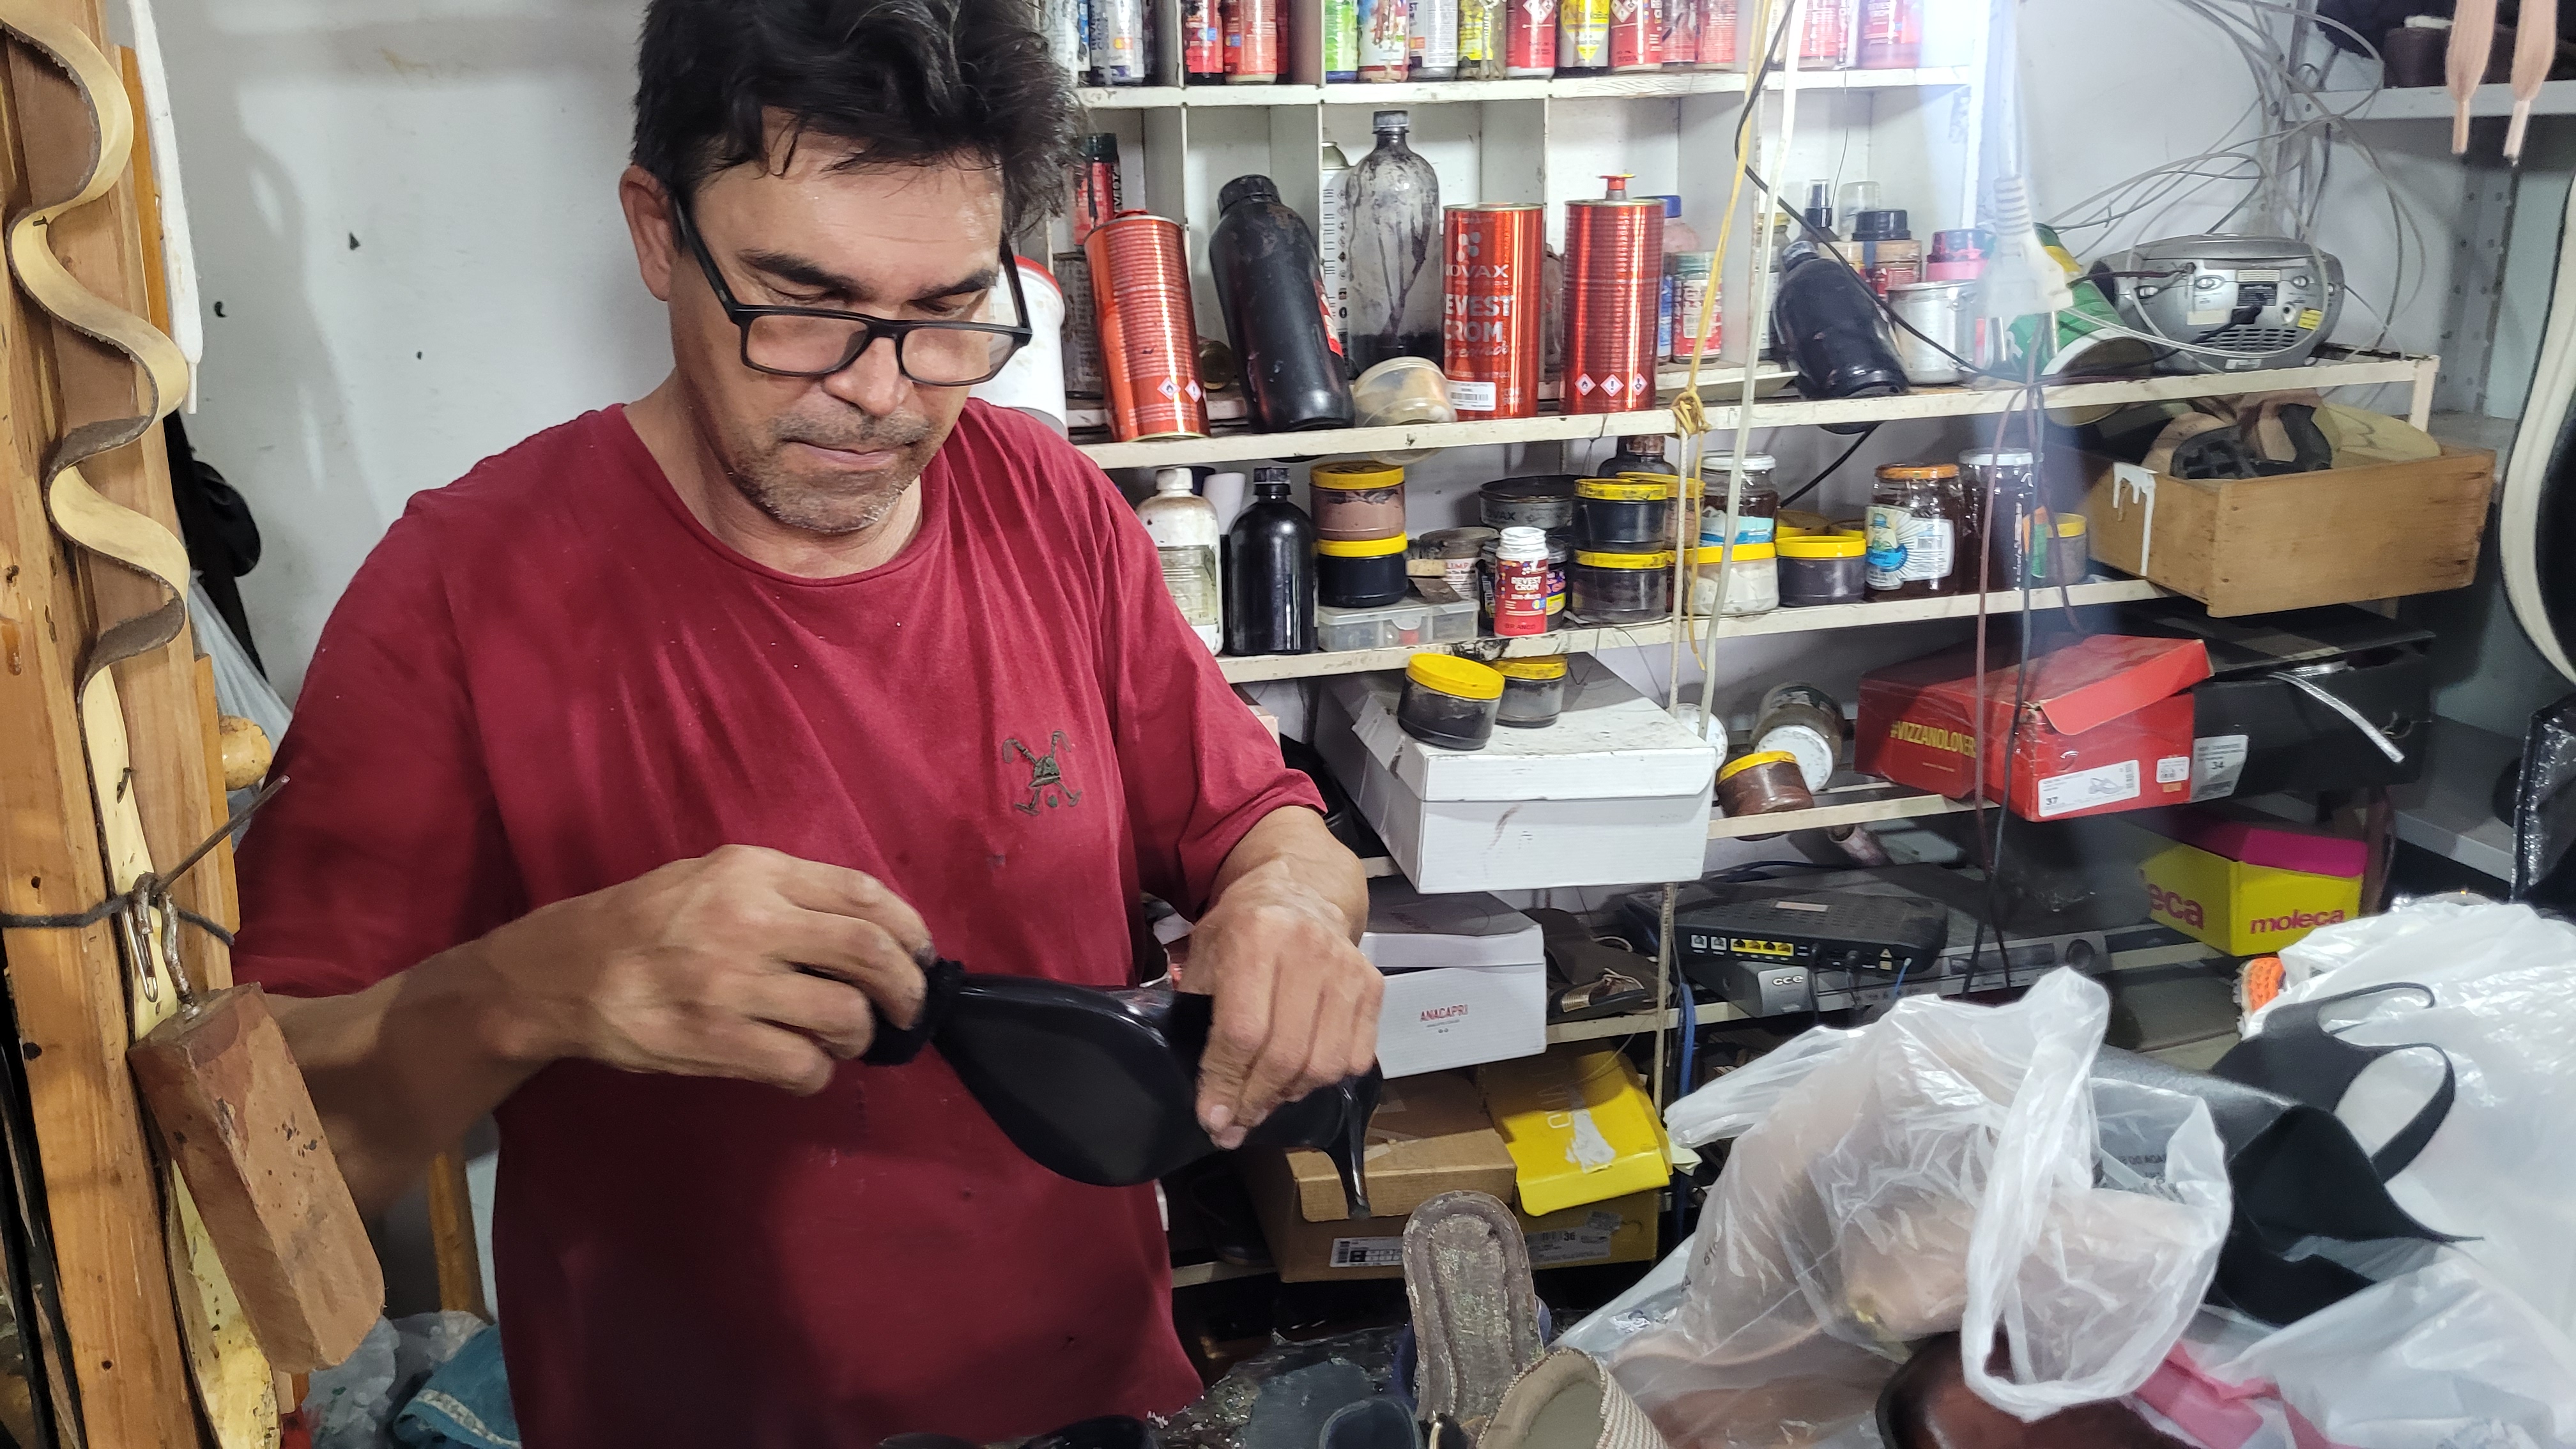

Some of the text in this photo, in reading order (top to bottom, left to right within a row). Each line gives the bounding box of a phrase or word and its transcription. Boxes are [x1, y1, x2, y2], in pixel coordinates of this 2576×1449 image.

[1445, 294, 1515, 317] EVEST
[2211, 761, 2225, 770] 34
[2045, 796, 2058, 806] 37
[2138, 869, 2204, 930] eca
[2250, 908, 2345, 934] moleca
[1773, 974, 1804, 986] cce
[1420, 1004, 1469, 1022] ANACAPRI
[1563, 1232, 1575, 1241] 36
